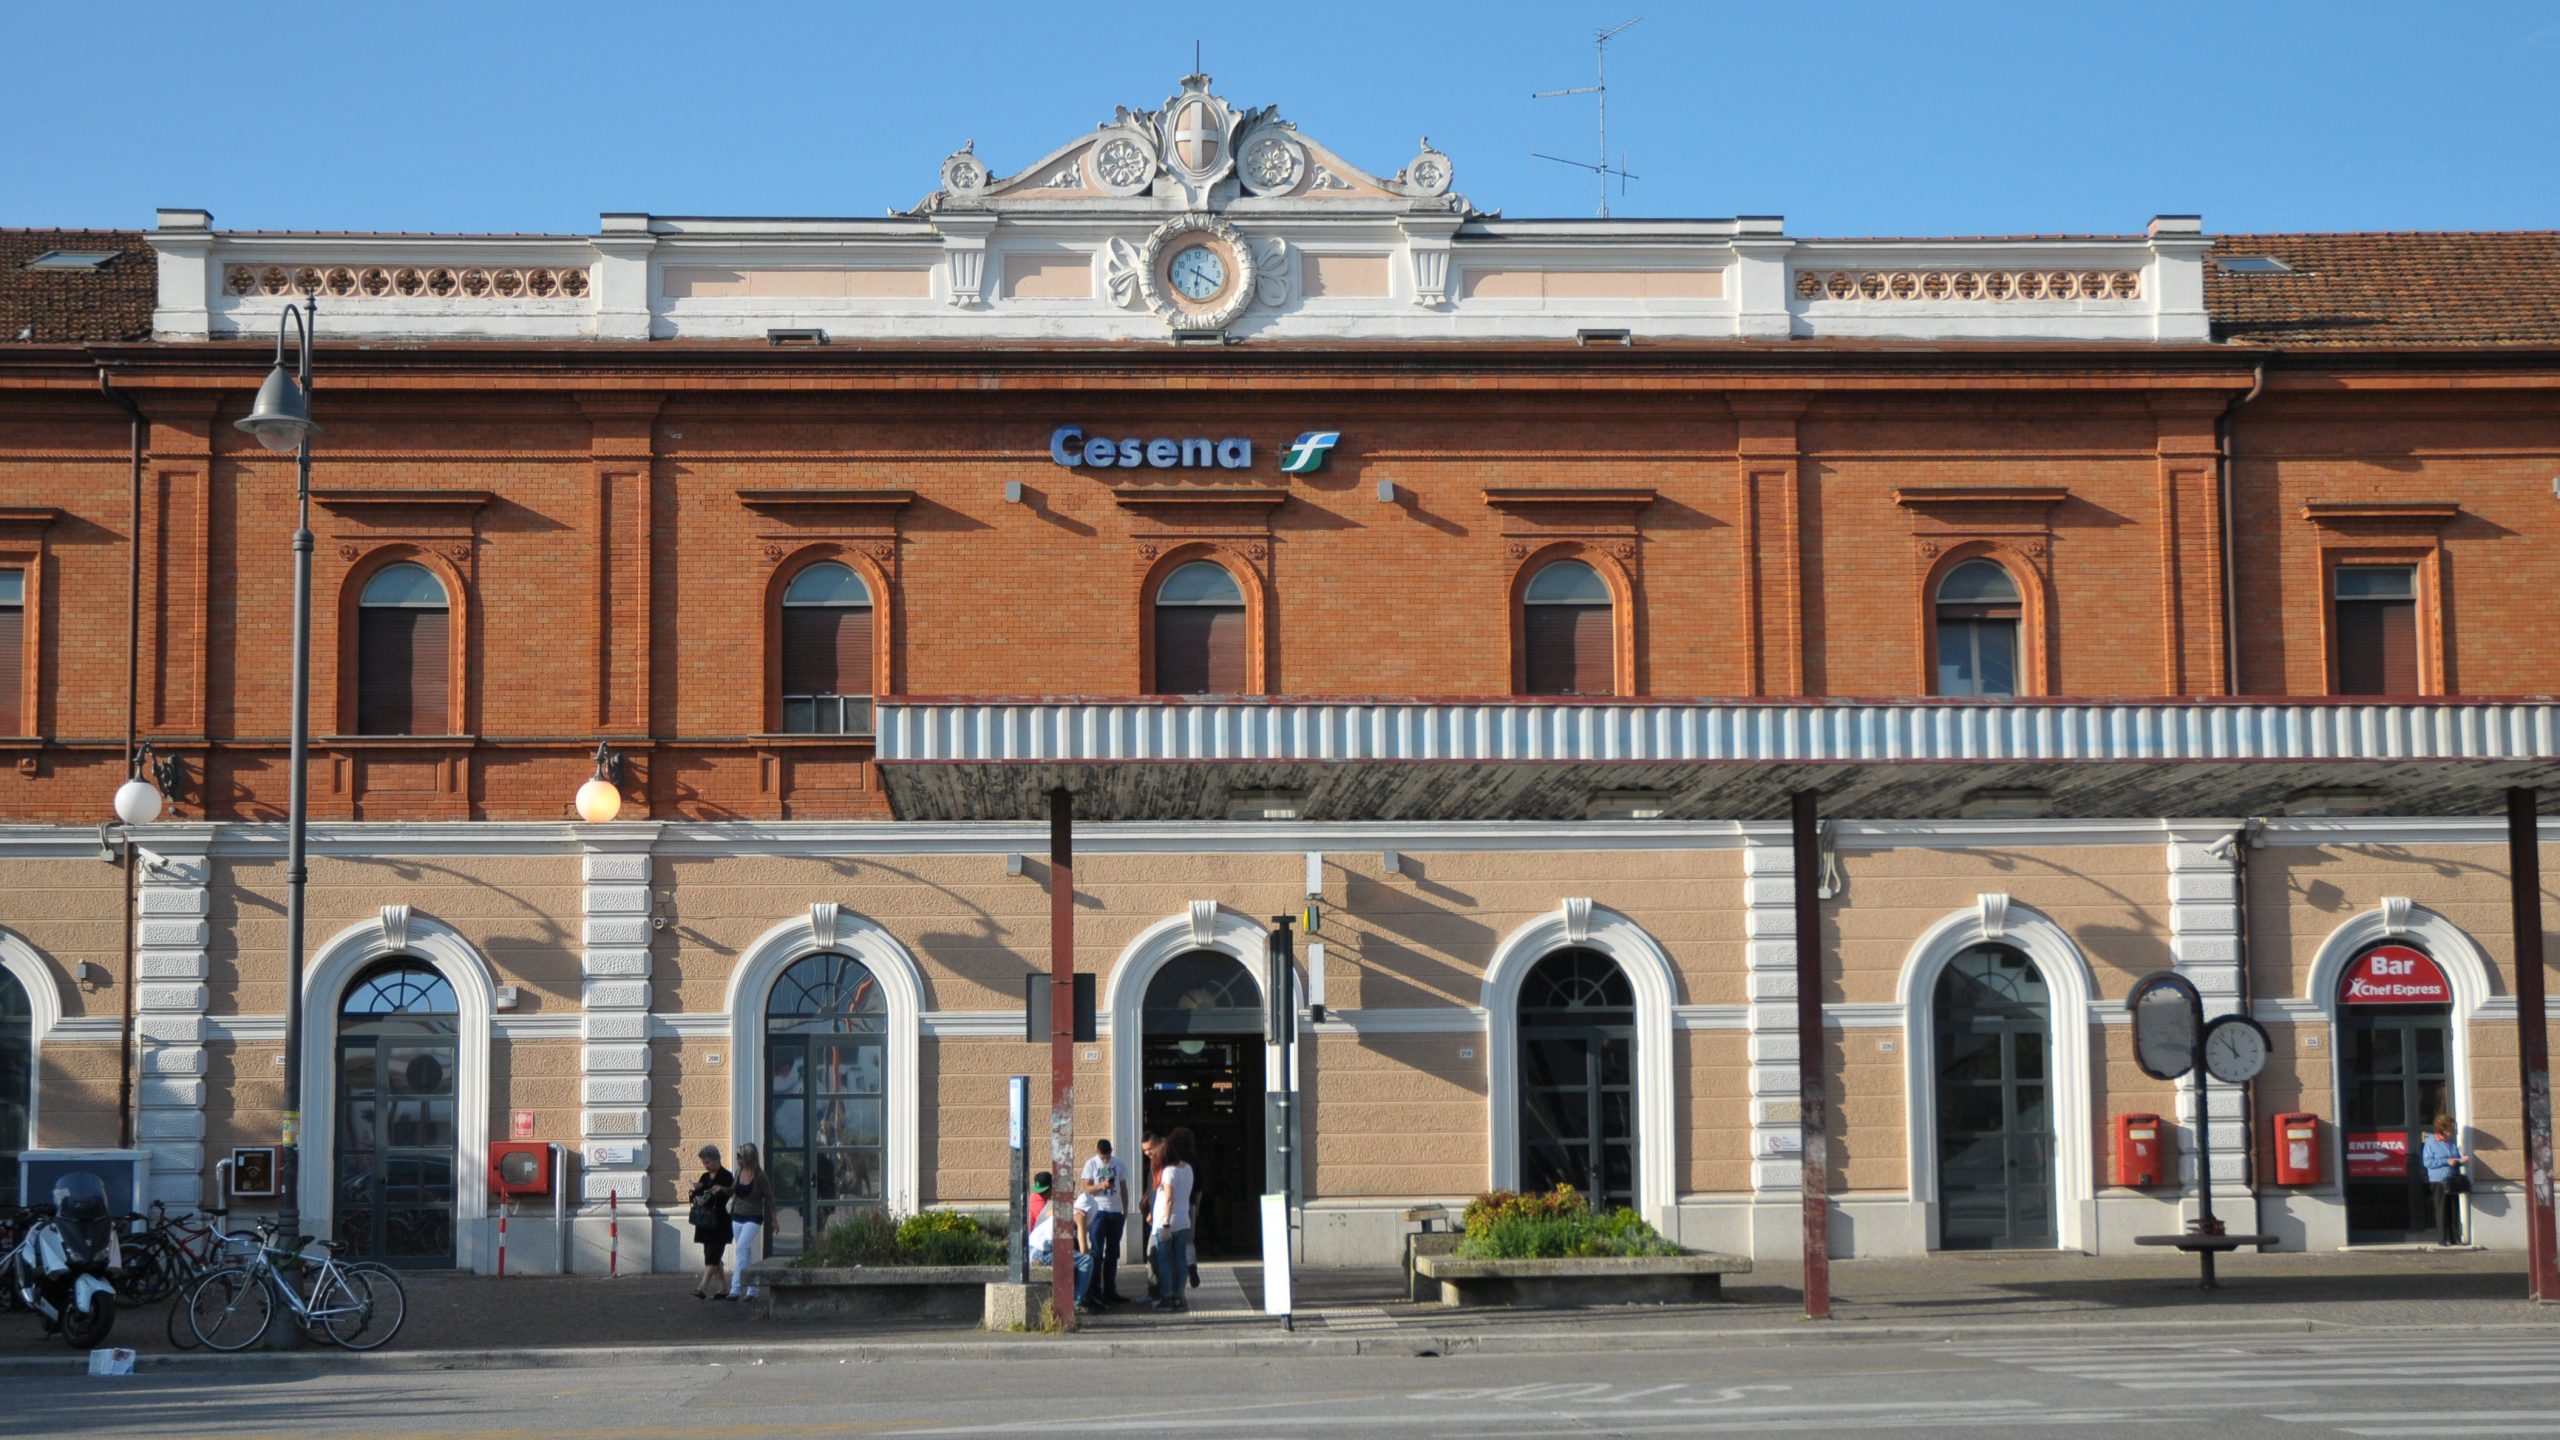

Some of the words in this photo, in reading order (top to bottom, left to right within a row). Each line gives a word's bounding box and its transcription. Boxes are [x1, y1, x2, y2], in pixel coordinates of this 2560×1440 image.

[1178, 261, 1185, 269] 10
[1212, 260, 1217, 268] 2
[1186, 287, 1191, 295] 7
[1050, 425, 1252, 468] Cesena
[2371, 957, 2415, 975] Bar
[2361, 985, 2391, 995] Chef
[2393, 985, 2441, 996] Express
[2349, 1141, 2404, 1150] ENTRATA
